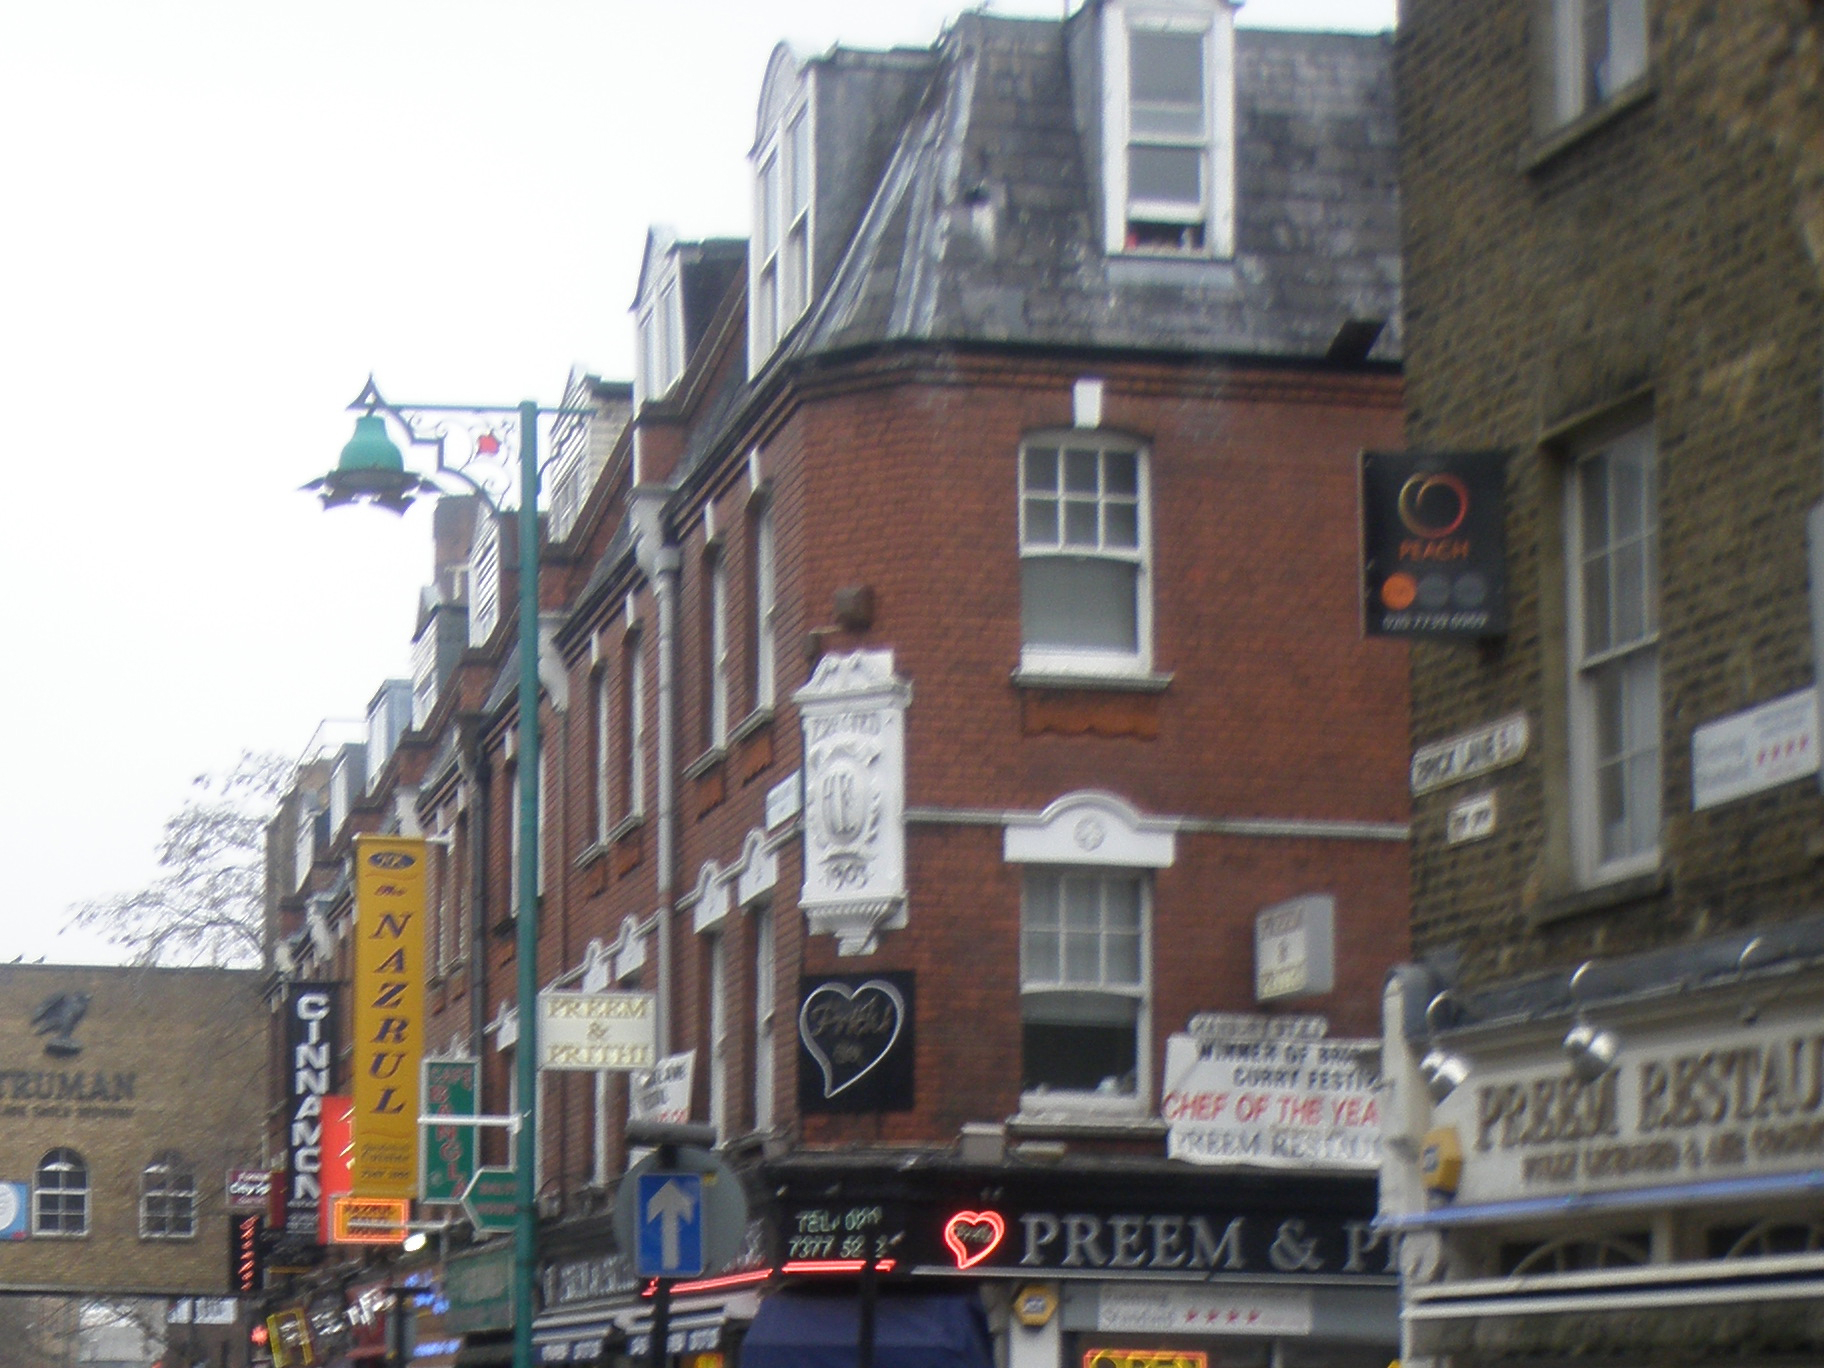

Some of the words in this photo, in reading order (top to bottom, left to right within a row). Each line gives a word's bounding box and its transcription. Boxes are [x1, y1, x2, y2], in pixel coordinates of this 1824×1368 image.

[367, 911, 416, 1117] NAZRUL
[547, 998, 647, 1019] PREEM
[1162, 1091, 1228, 1122] CHEF
[1235, 1092, 1272, 1123] OF
[1277, 1094, 1325, 1125] THE
[1331, 1097, 1379, 1127] YEA
[1475, 1065, 1622, 1152] PREEM
[1019, 1212, 1247, 1267] PREEM
[1269, 1217, 1325, 1272] &
